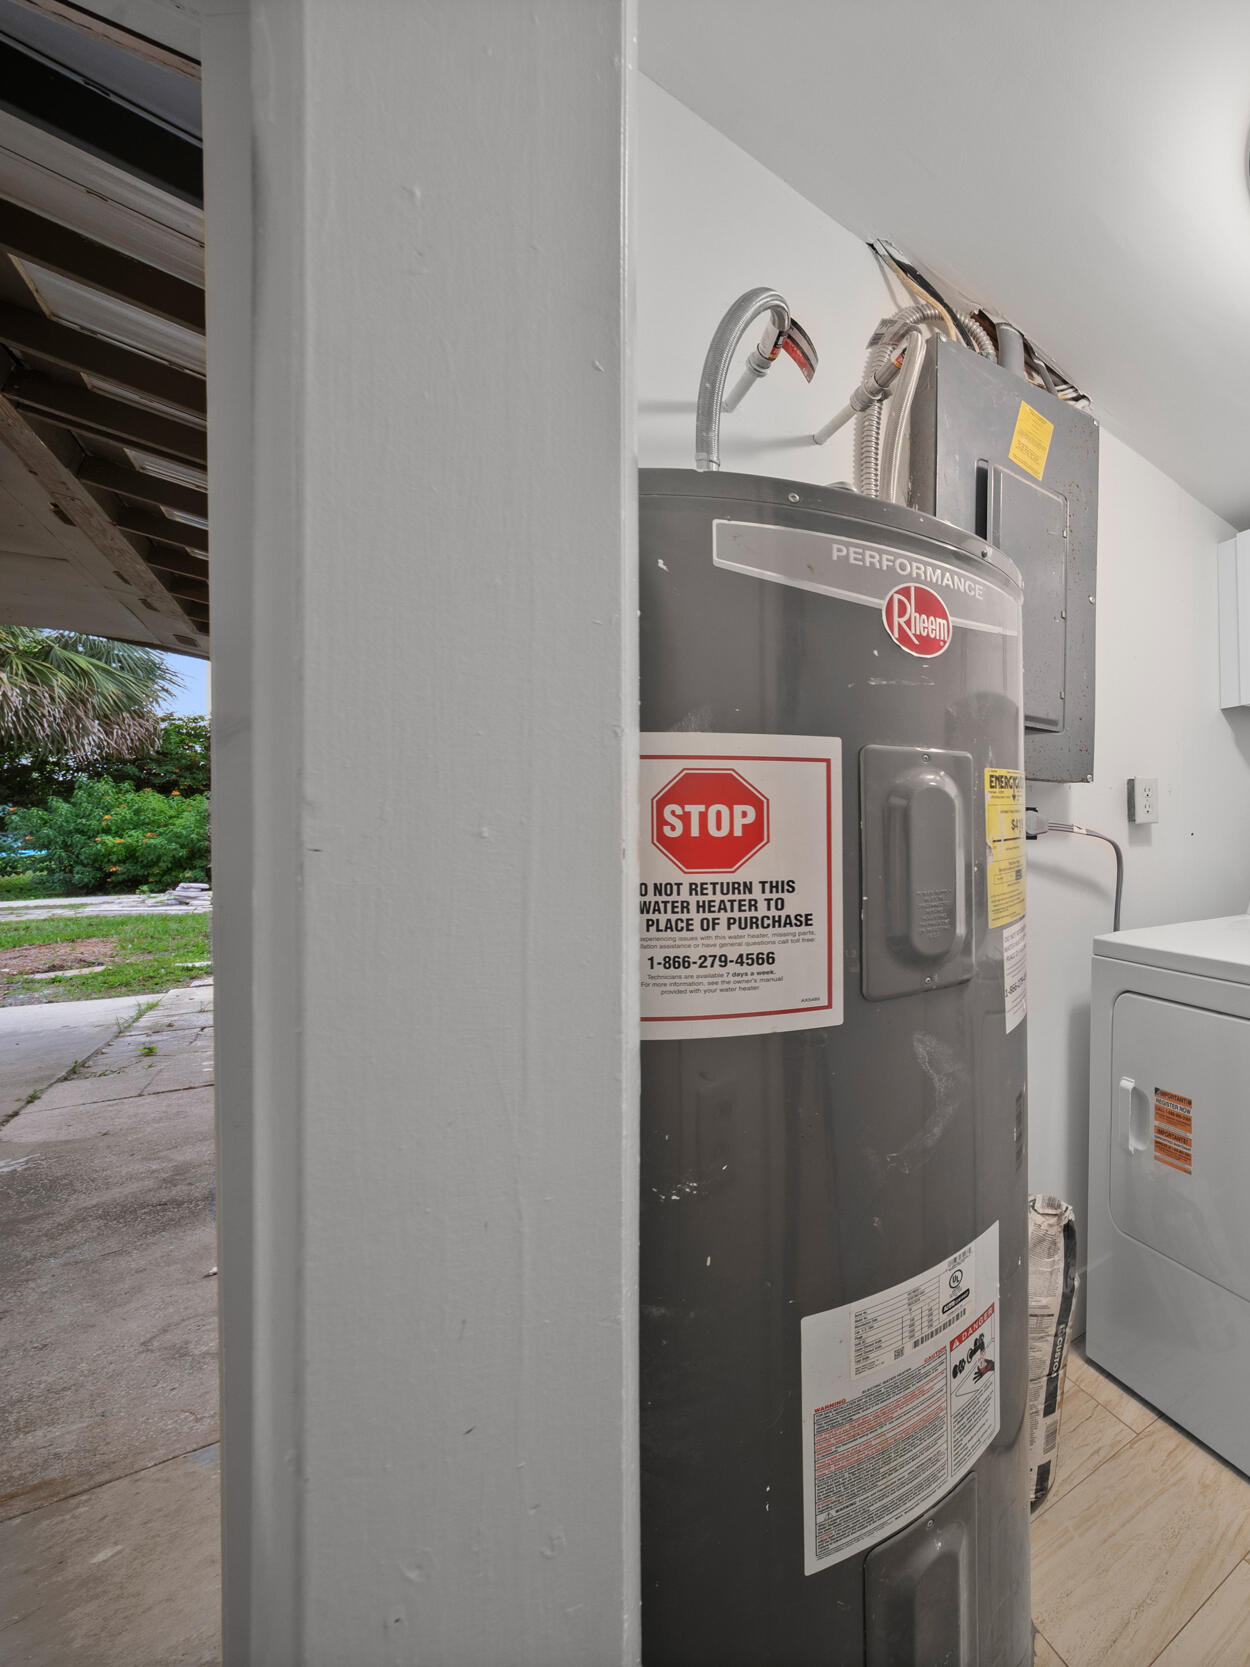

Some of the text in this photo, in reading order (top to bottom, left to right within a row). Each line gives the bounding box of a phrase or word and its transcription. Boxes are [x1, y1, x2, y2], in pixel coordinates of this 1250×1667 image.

[832, 544, 984, 600] PERFORMANCE
[893, 585, 948, 645] Rheem
[663, 803, 757, 838] STOP
[653, 882, 683, 897] NOT
[688, 881, 753, 897] RETURN
[758, 879, 796, 895] THIS
[639, 897, 785, 915] WATER HEATER TO
[645, 913, 814, 933] PLACE OF PURCHASE
[647, 951, 776, 970] 1-866-279-4566
[733, 977, 758, 985] owner's
[1179, 1106, 1191, 1115] NOW
[962, 1307, 993, 1338] DANGER
